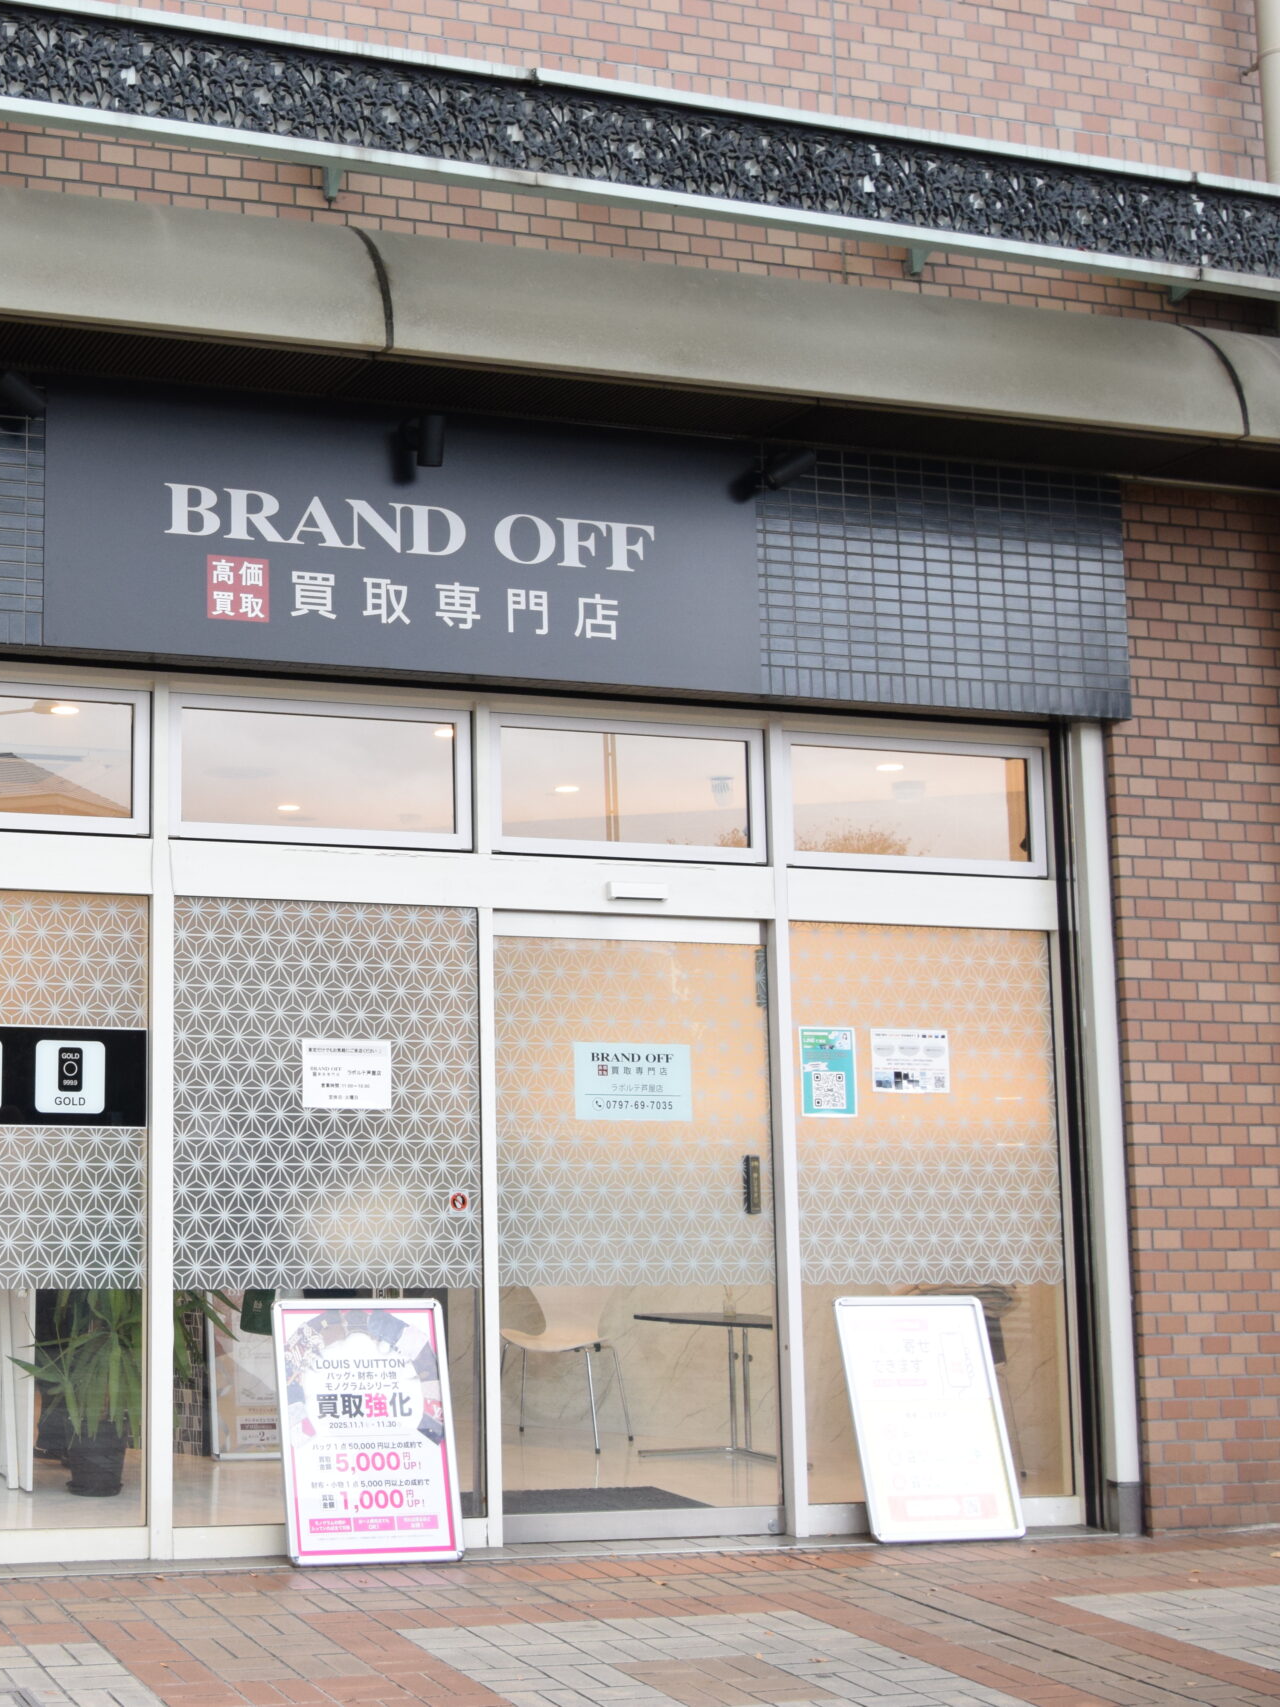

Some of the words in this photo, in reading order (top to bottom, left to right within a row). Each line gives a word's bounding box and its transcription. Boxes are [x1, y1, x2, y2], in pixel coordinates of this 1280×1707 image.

[164, 482, 467, 556] BRAND
[493, 513, 655, 572] OFF
[211, 560, 264, 588] 高価
[211, 591, 266, 619] 買取
[290, 570, 619, 641] 買取専門店
[591, 1052, 641, 1063] BRAND
[645, 1053, 674, 1063] OFF
[611, 1066, 668, 1076] 買取専門店
[54, 1096, 86, 1106] GOLD
[606, 1100, 673, 1110] 0797-69-7035
[315, 1359, 351, 1369] LOUIS
[353, 1358, 406, 1369] VUITTON
[325, 1381, 400, 1391] モノグラムシリーズ
[316, 1391, 413, 1419] 買取強化
[335, 1451, 401, 1475] 5,000
[339, 1489, 404, 1513] 1,000
